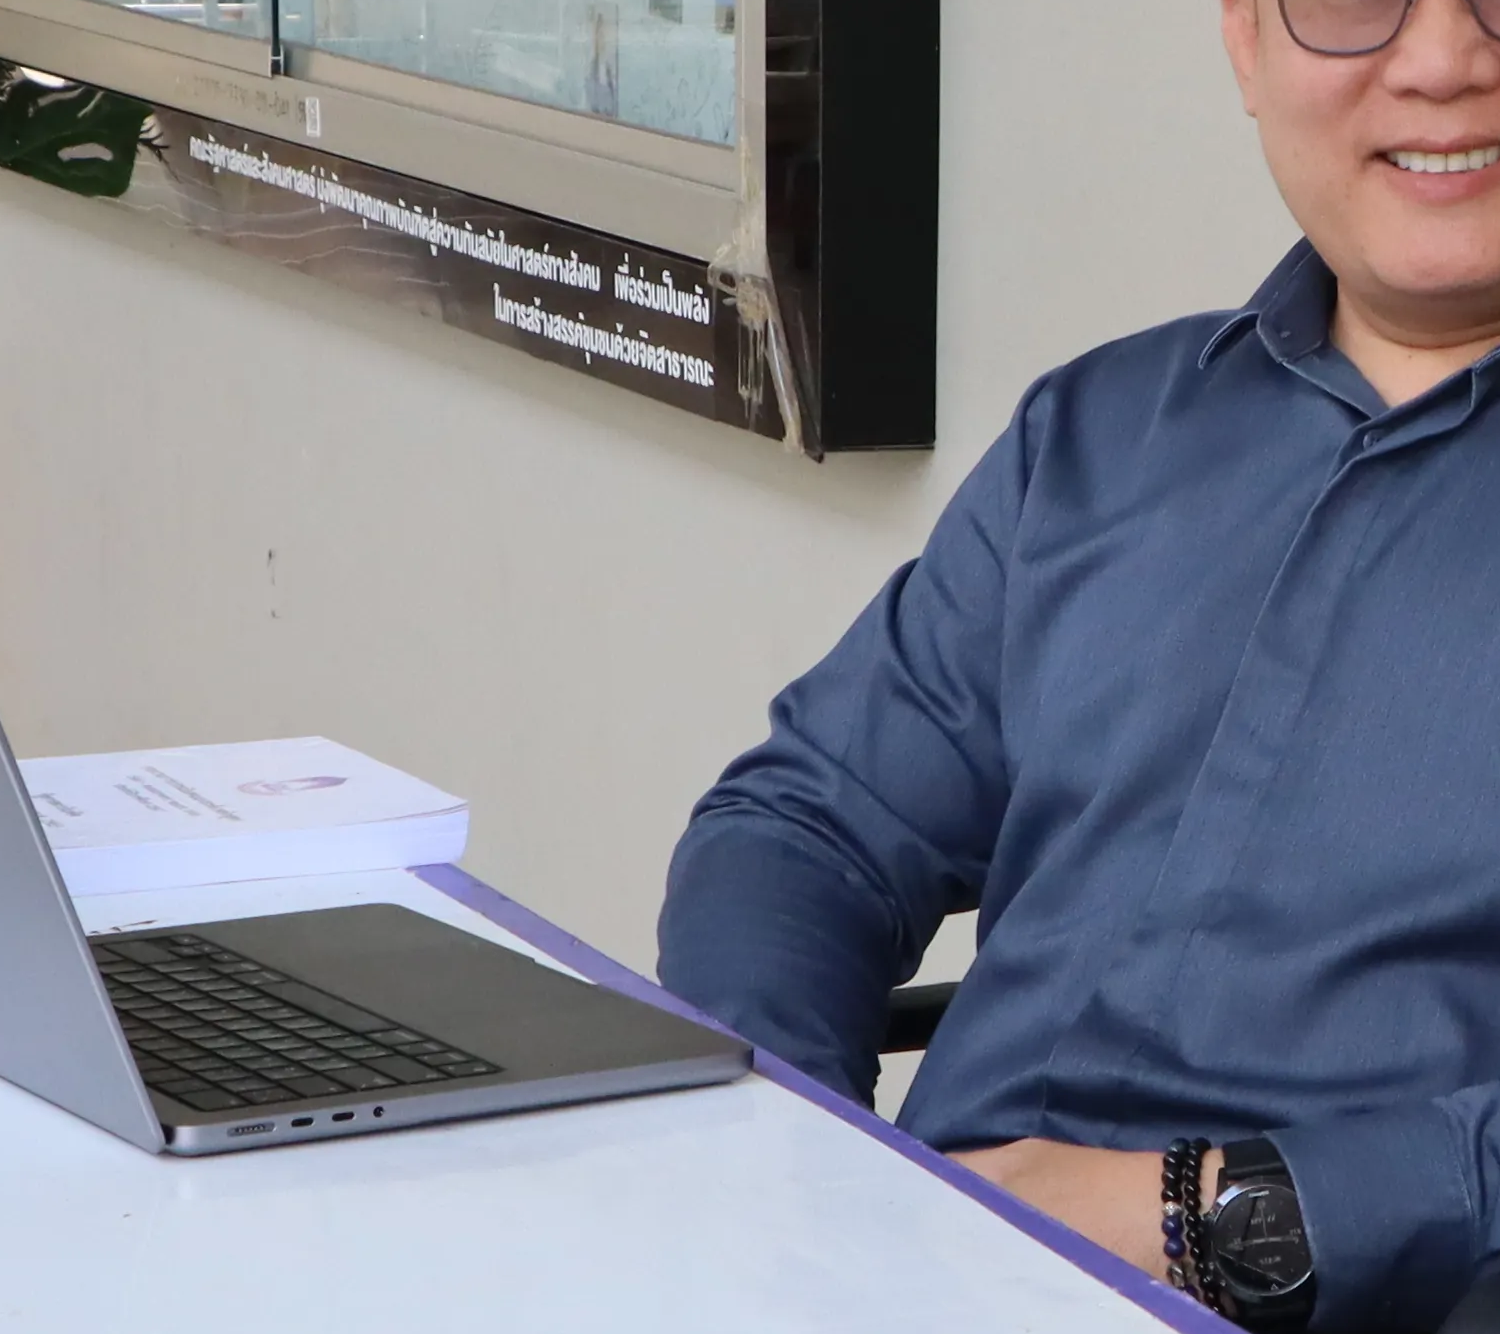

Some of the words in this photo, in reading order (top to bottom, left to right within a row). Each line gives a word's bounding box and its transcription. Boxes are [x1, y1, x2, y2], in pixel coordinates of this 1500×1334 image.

[614, 252, 710, 325] เพื่อร่วมเป็นพลัง
